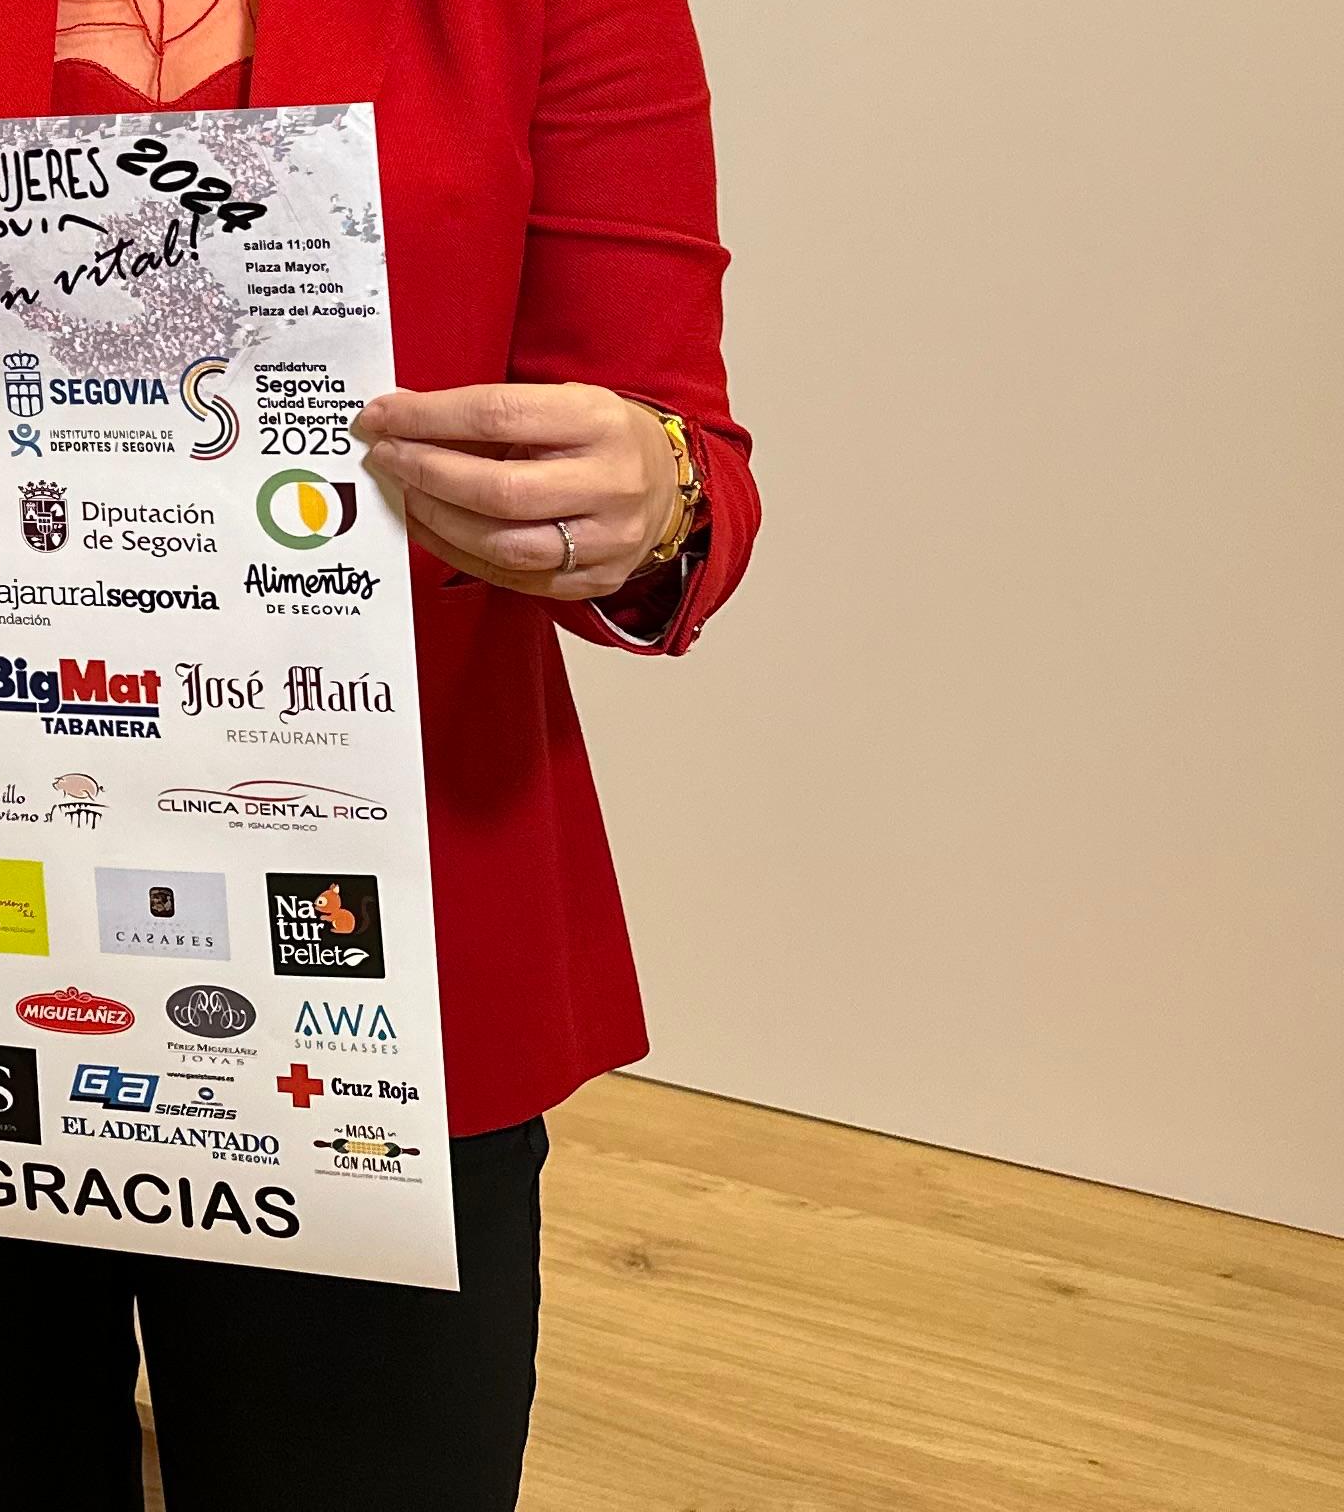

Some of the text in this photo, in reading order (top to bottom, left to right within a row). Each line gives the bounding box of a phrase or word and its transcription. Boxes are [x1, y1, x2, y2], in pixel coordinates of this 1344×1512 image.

[116, 138, 268, 233] 2024
[54, 212, 200, 290] vital!
[244, 240, 283, 251] salida
[245, 262, 330, 274] Plaza Mayor,
[247, 284, 295, 296] llegada
[250, 306, 284, 316] Plaza
[289, 306, 308, 316] del
[254, 361, 327, 372] candidatura
[50, 378, 169, 405] SEGOVIA
[255, 375, 346, 397] Segovia
[257, 397, 364, 412] Ciudad Europea
[258, 413, 348, 428] del Deporte
[49, 429, 173, 440] INSTITUTO MUNICIPAL DE
[259, 427, 351, 456] 2025
[50, 441, 176, 453] DEPORTES SEGOVIA
[81, 499, 215, 527] Diputación
[83, 529, 218, 558] de Segovia
[243, 563, 381, 600] Alimentos
[266, 604, 361, 616] DE SEGOVIA
[174, 662, 396, 726] José María
[40, 716, 162, 739] TABANERA
[226, 730, 350, 747] RESTAURANTE
[157, 798, 388, 821] CLINICA DENTAL RICO
[275, 895, 315, 919] Na
[276, 918, 324, 942] tur
[280, 944, 343, 966] Pellet
[23, 1004, 128, 1026] MIGUELAÑEZ
[294, 1000, 397, 1041] AWA
[294, 1038, 400, 1055] SUNGLASSES
[331, 1077, 420, 1102] Cruz Roja
[155, 1103, 238, 1120] sistemas
[61, 1115, 280, 1156] EL ADELANTADO
[345, 1124, 386, 1141] MASA
[231, 1152, 280, 1166] SEGOVIA
[333, 1155, 403, 1175] CON ALMA
